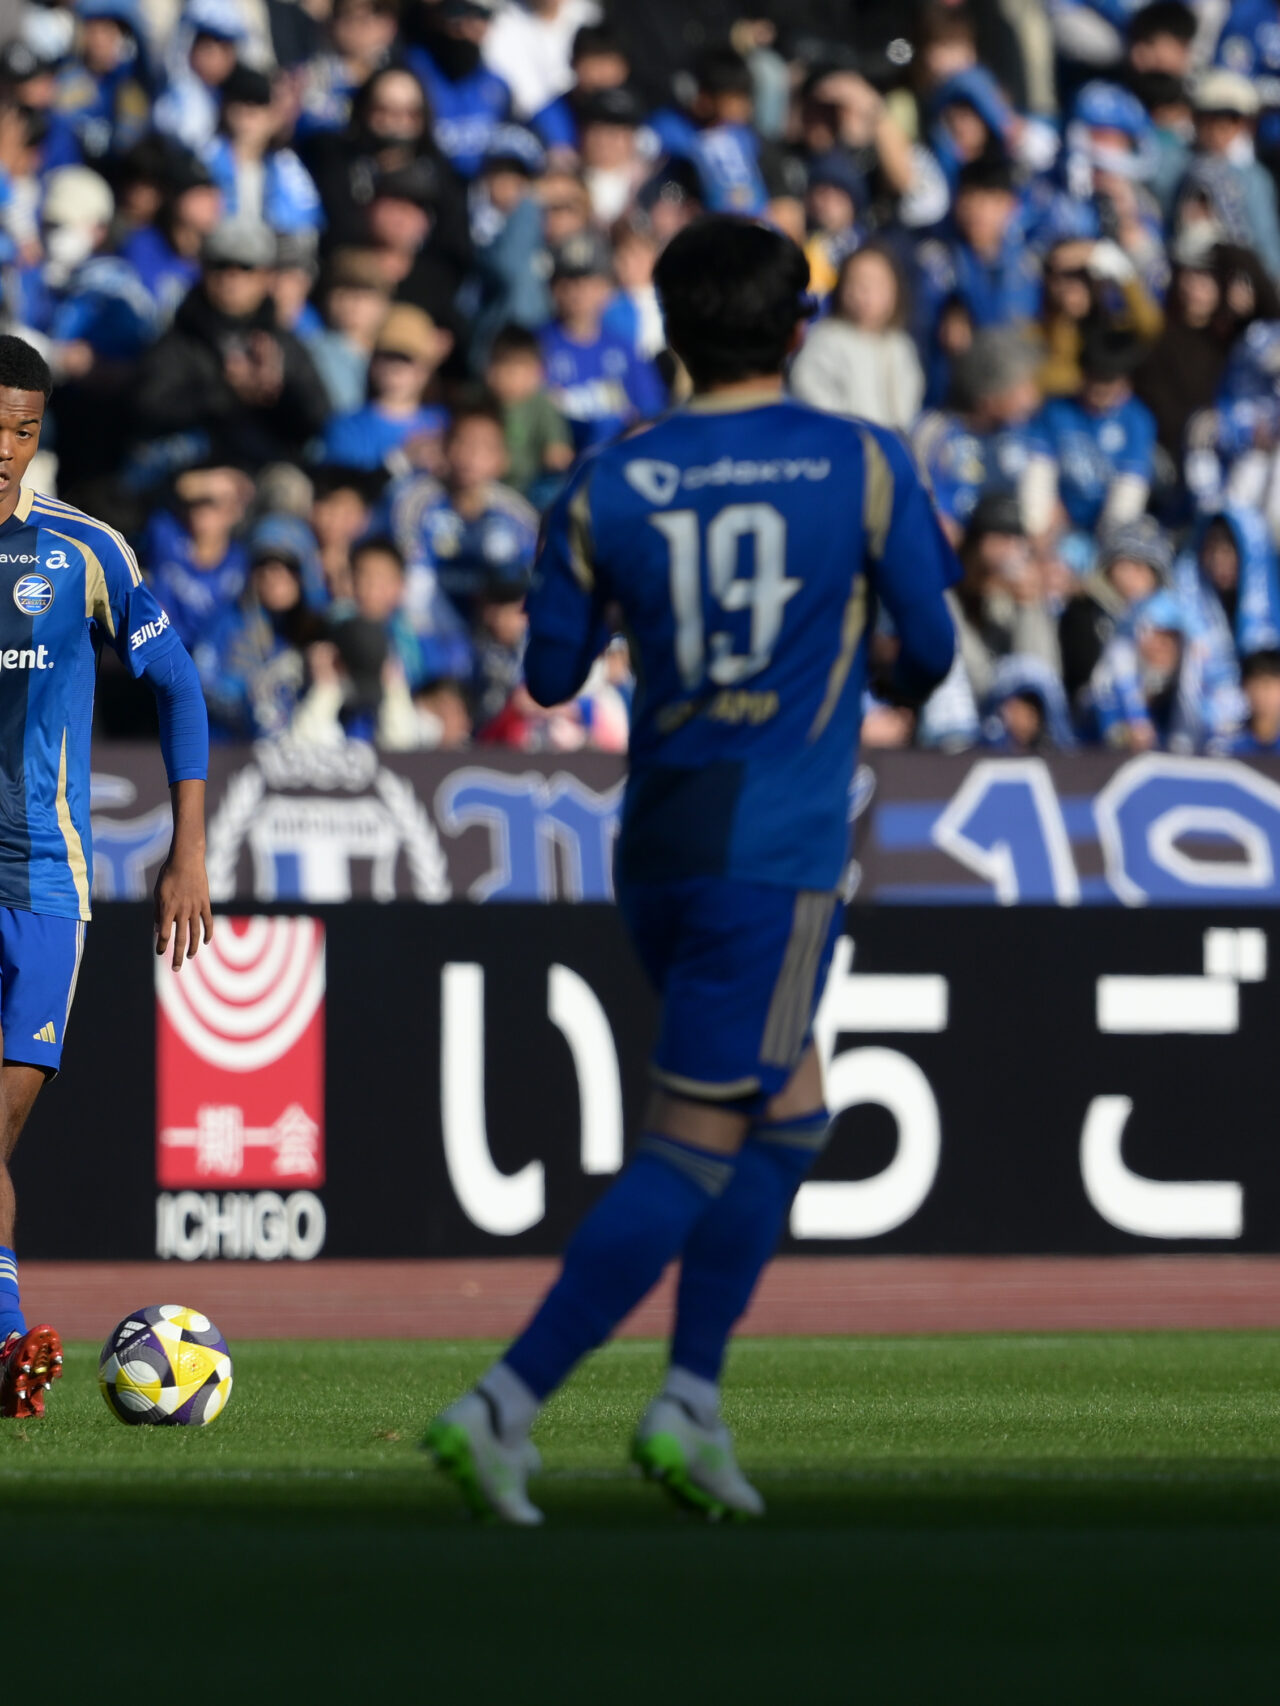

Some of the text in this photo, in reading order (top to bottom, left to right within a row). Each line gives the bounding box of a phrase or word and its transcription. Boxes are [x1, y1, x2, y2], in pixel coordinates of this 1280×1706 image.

[647, 502, 803, 691] 19
[160, 1101, 320, 1178] 一期一会
[440, 927, 1268, 1240] いちご
[155, 1190, 326, 1261] ICHIGO
